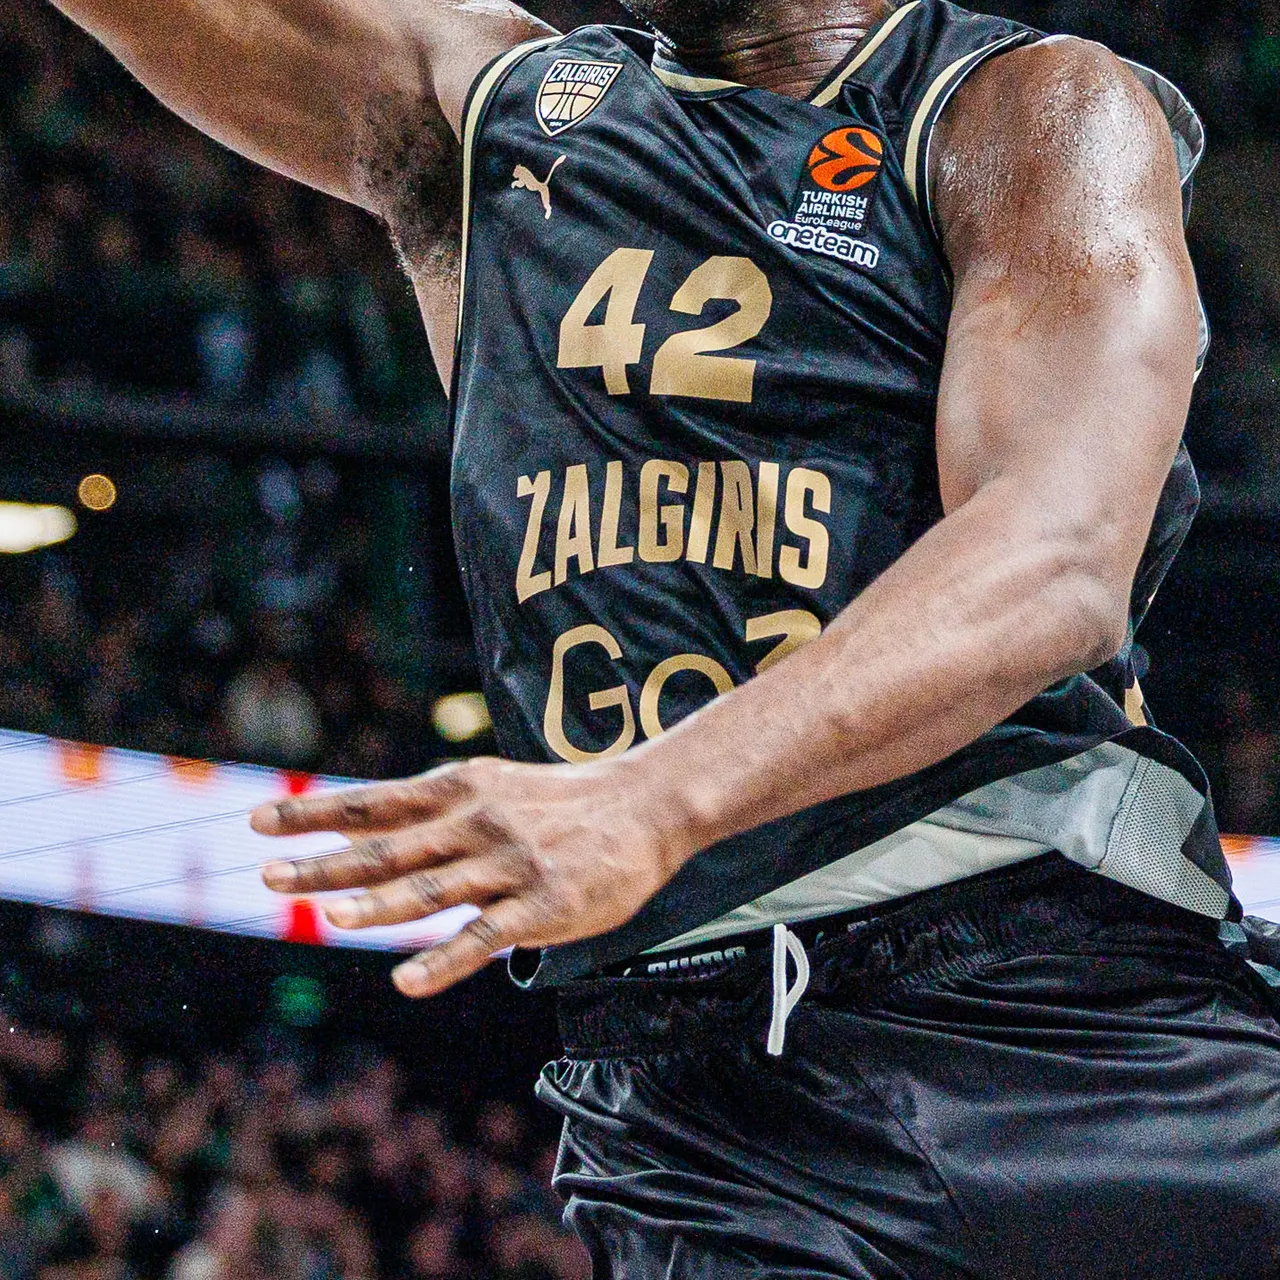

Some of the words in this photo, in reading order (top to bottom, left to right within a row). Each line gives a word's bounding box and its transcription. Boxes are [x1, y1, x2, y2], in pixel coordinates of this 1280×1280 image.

[801, 190, 868, 209] TURKISH
[796, 202, 865, 220] AIRLINES
[794, 213, 862, 231] EuroLeague
[770, 222, 877, 266] oneteam
[556, 247, 773, 404] 42
